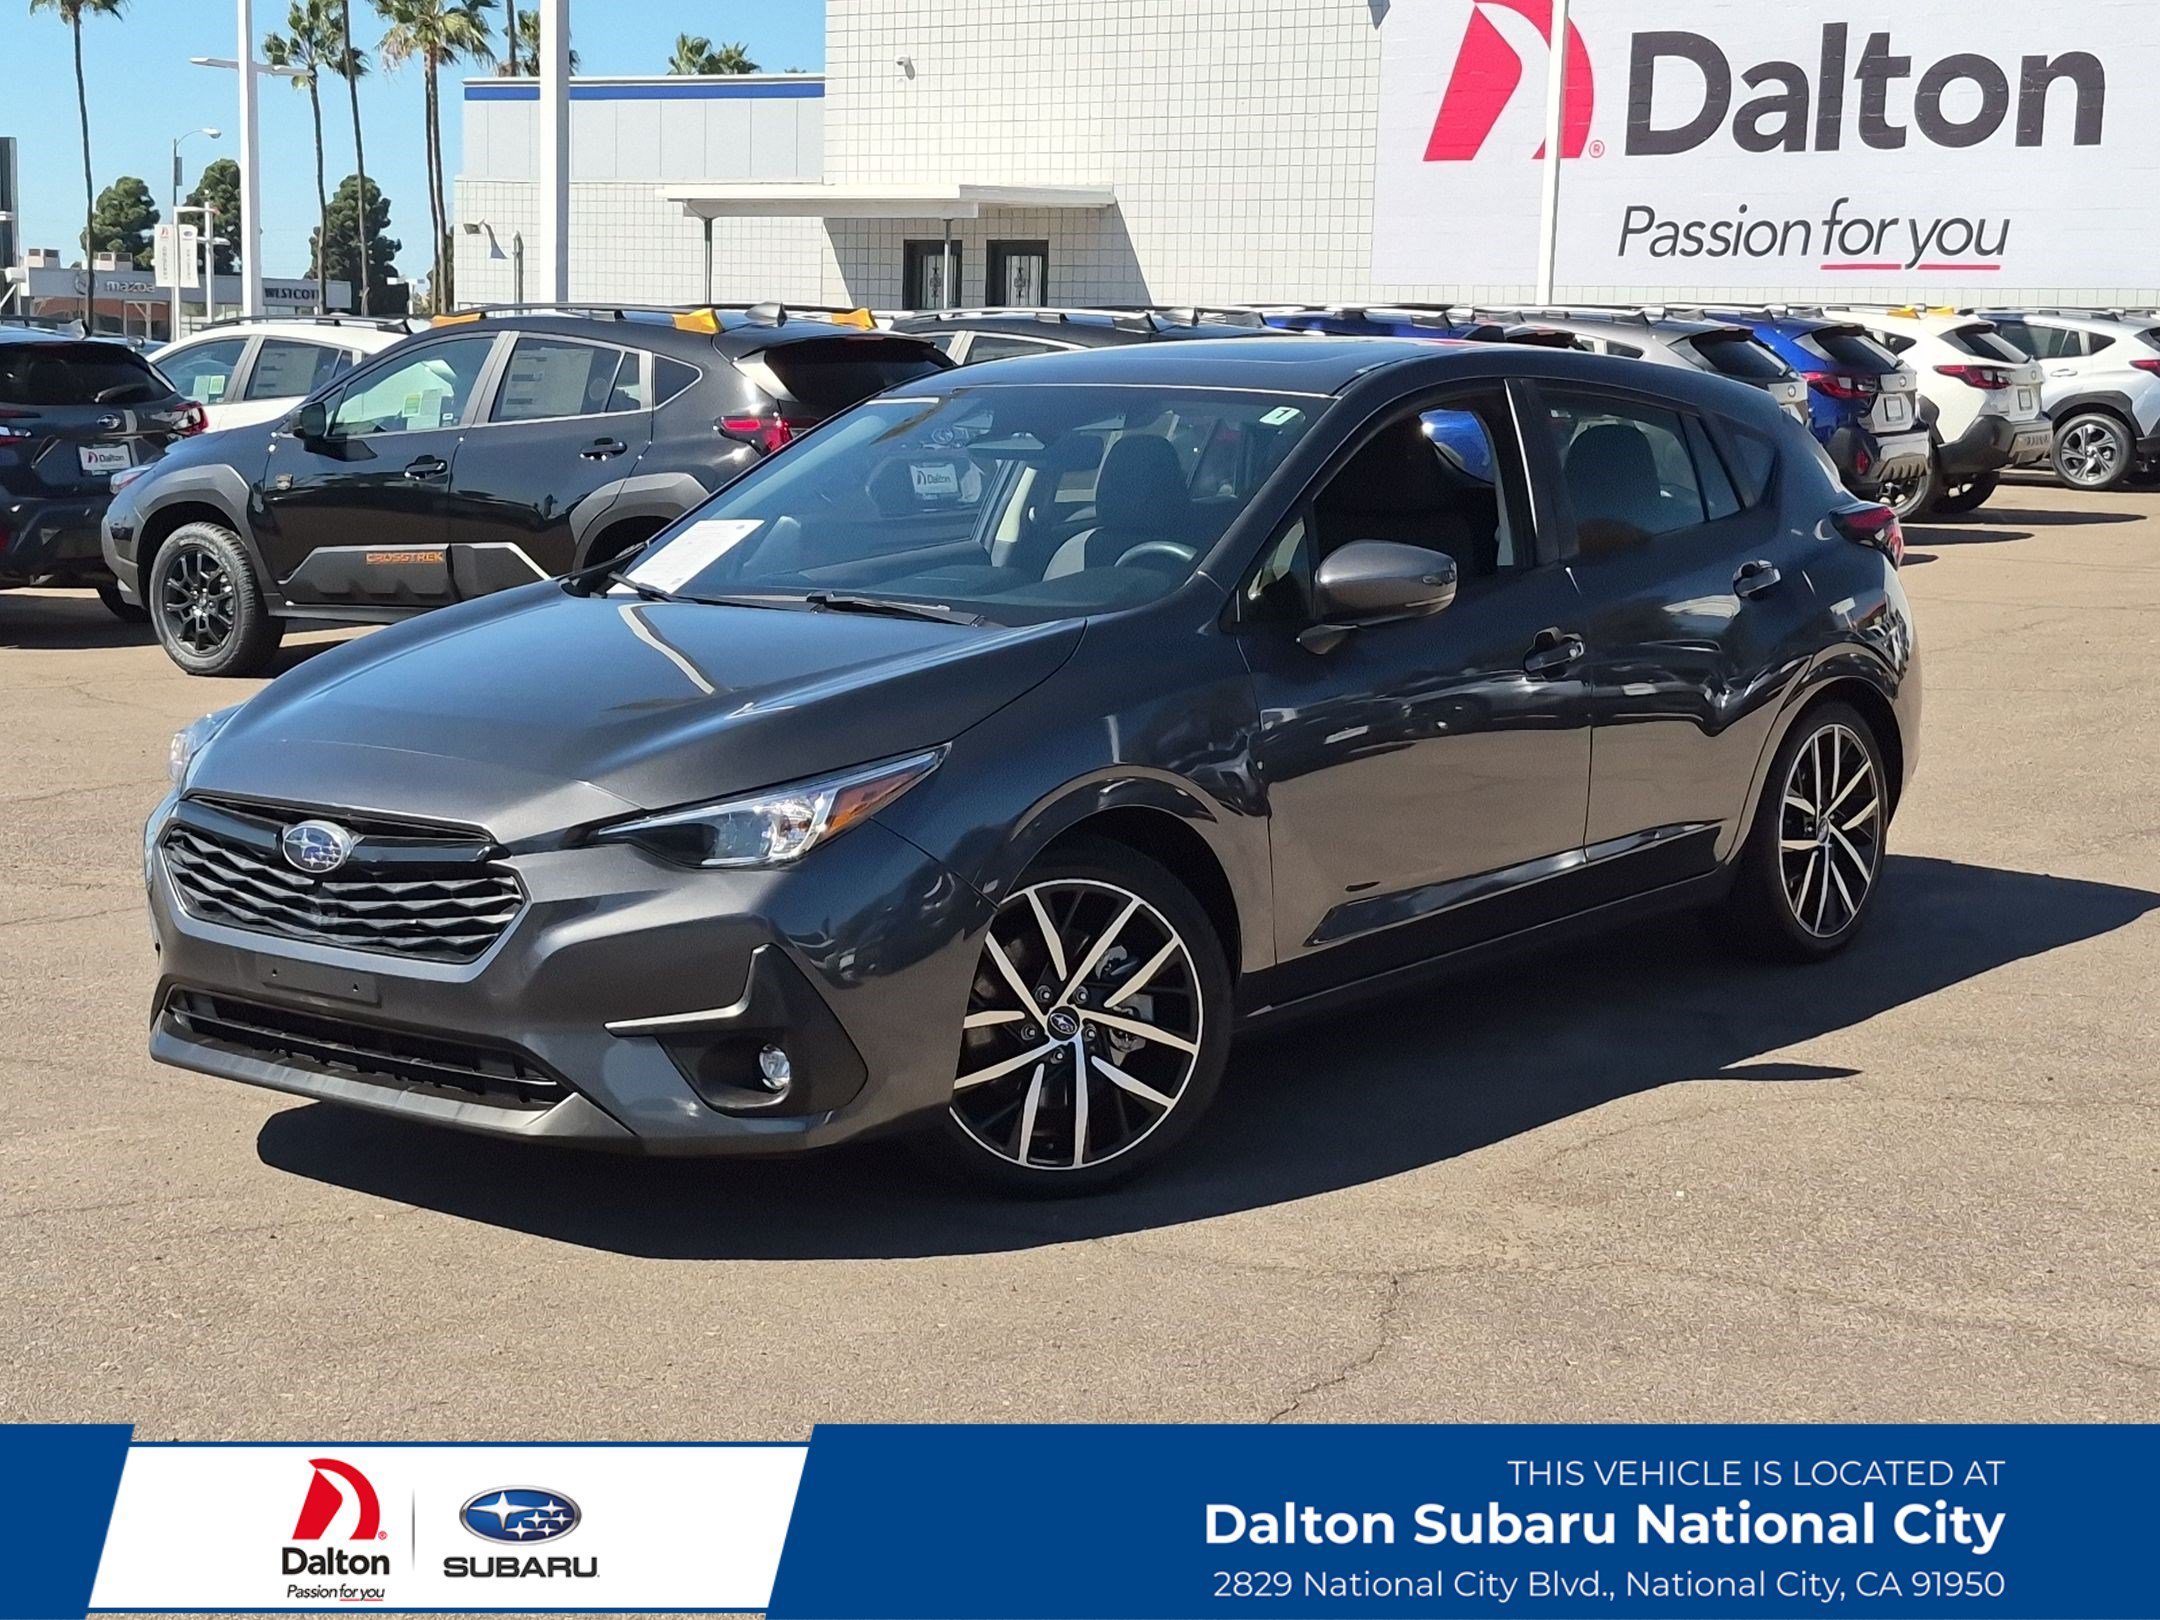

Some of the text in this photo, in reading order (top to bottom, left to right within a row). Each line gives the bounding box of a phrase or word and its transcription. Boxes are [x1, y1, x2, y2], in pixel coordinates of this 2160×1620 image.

[1625, 22, 2106, 157] Dalton
[1618, 197, 2010, 270] Passion for you
[927, 473, 951, 484] Dalton
[366, 552, 444, 565] CROSSTREK
